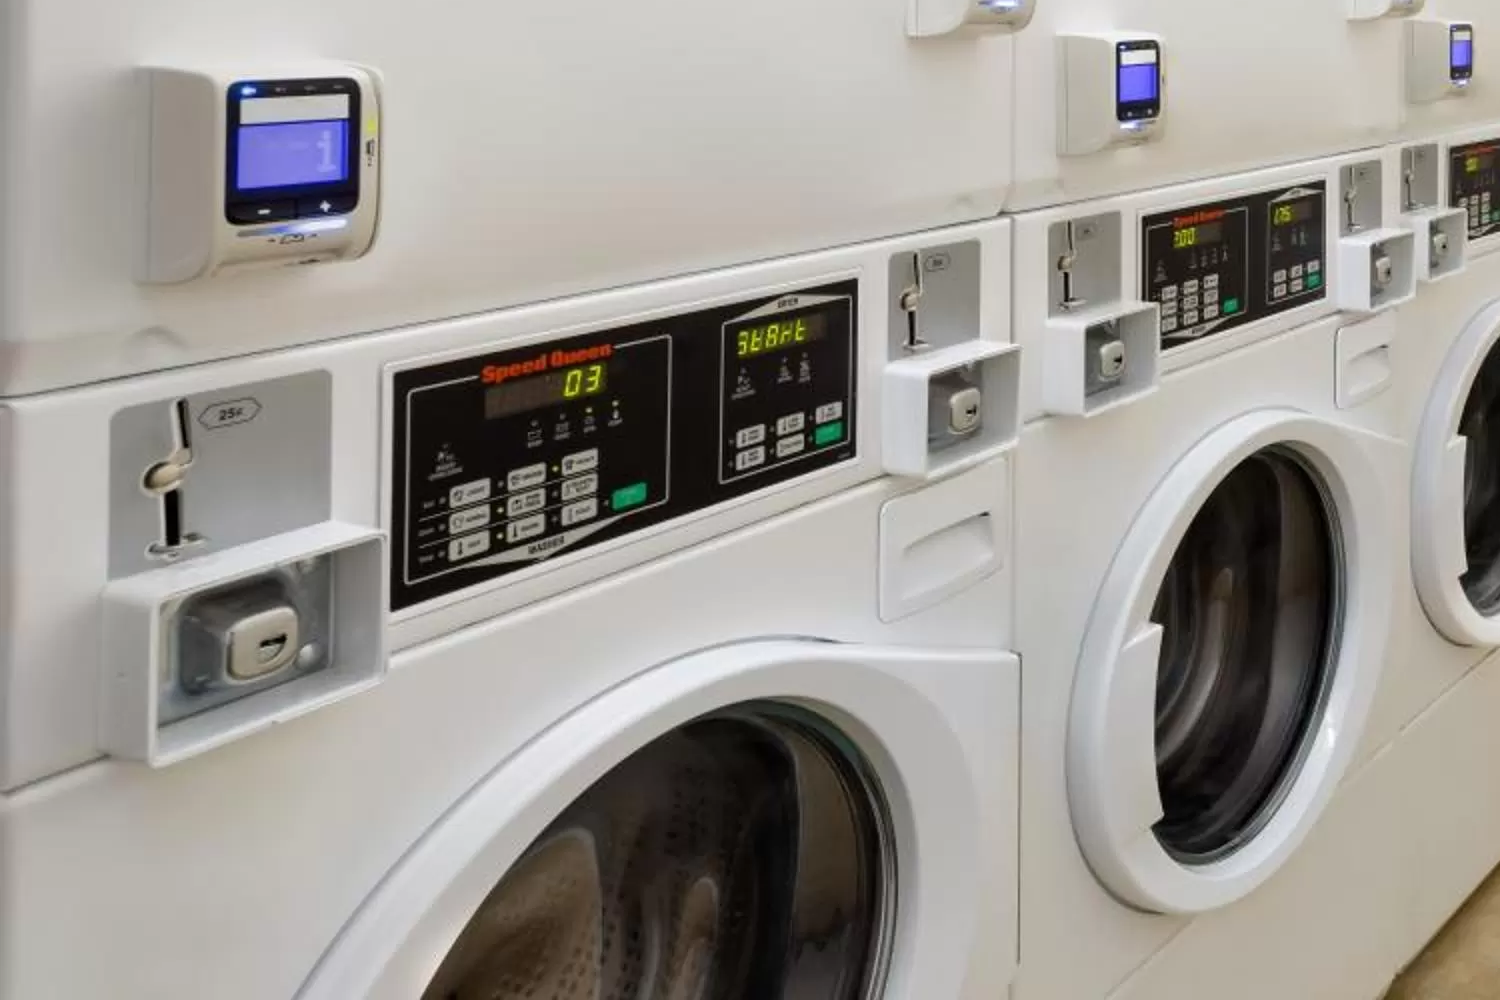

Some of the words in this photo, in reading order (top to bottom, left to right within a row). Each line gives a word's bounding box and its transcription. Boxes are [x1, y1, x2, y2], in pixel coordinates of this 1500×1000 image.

[481, 353, 548, 385] Speed
[551, 344, 613, 368] Queen
[563, 364, 602, 397] 03
